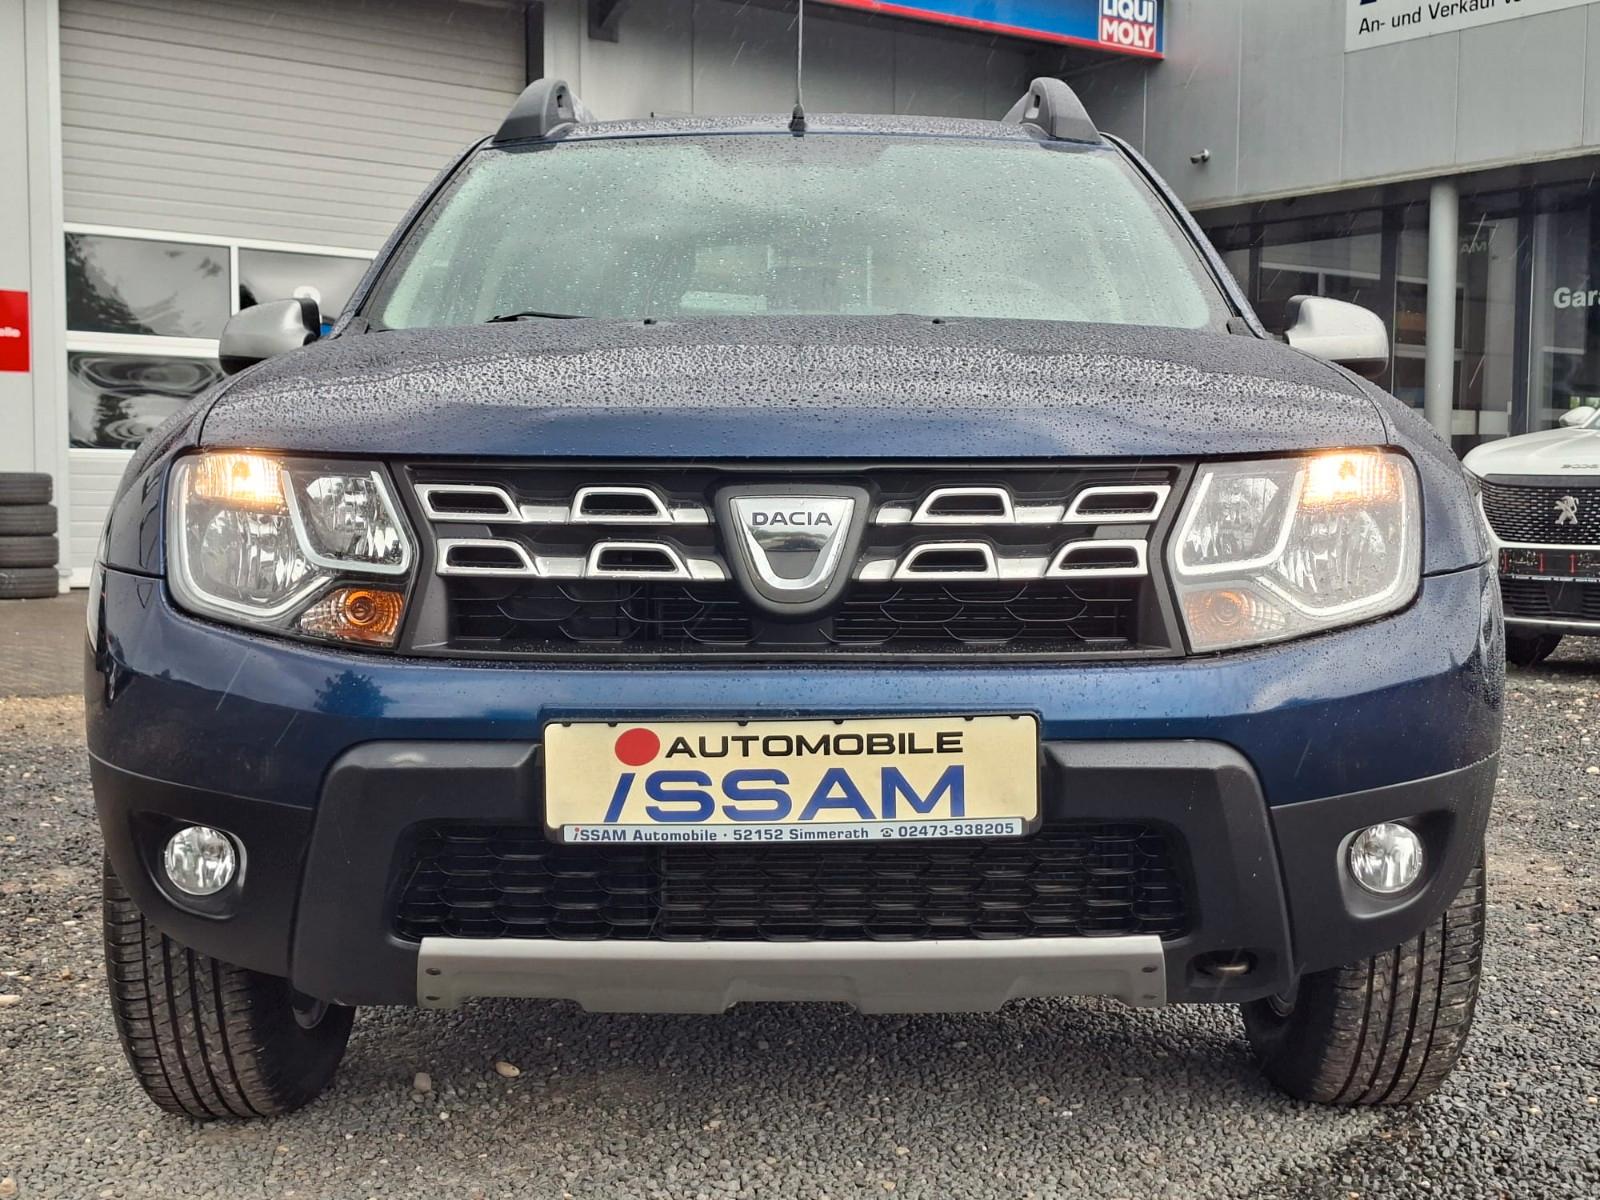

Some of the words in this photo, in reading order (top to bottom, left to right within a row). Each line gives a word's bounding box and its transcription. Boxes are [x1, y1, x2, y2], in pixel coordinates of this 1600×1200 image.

[1103, 0, 1154, 23] LIQUI
[1359, 17, 1386, 35] An-
[1391, 6, 1422, 28] und
[1102, 18, 1154, 48] MOLY
[1553, 286, 1600, 309] Gar
[751, 511, 833, 526] DACIA
[665, 731, 964, 758] AUTOMOBILE
[632, 828, 718, 841] Automobile
[733, 828, 784, 841] 52152
[789, 828, 869, 841] Simmerath
[898, 822, 1015, 838] 02473-938205
